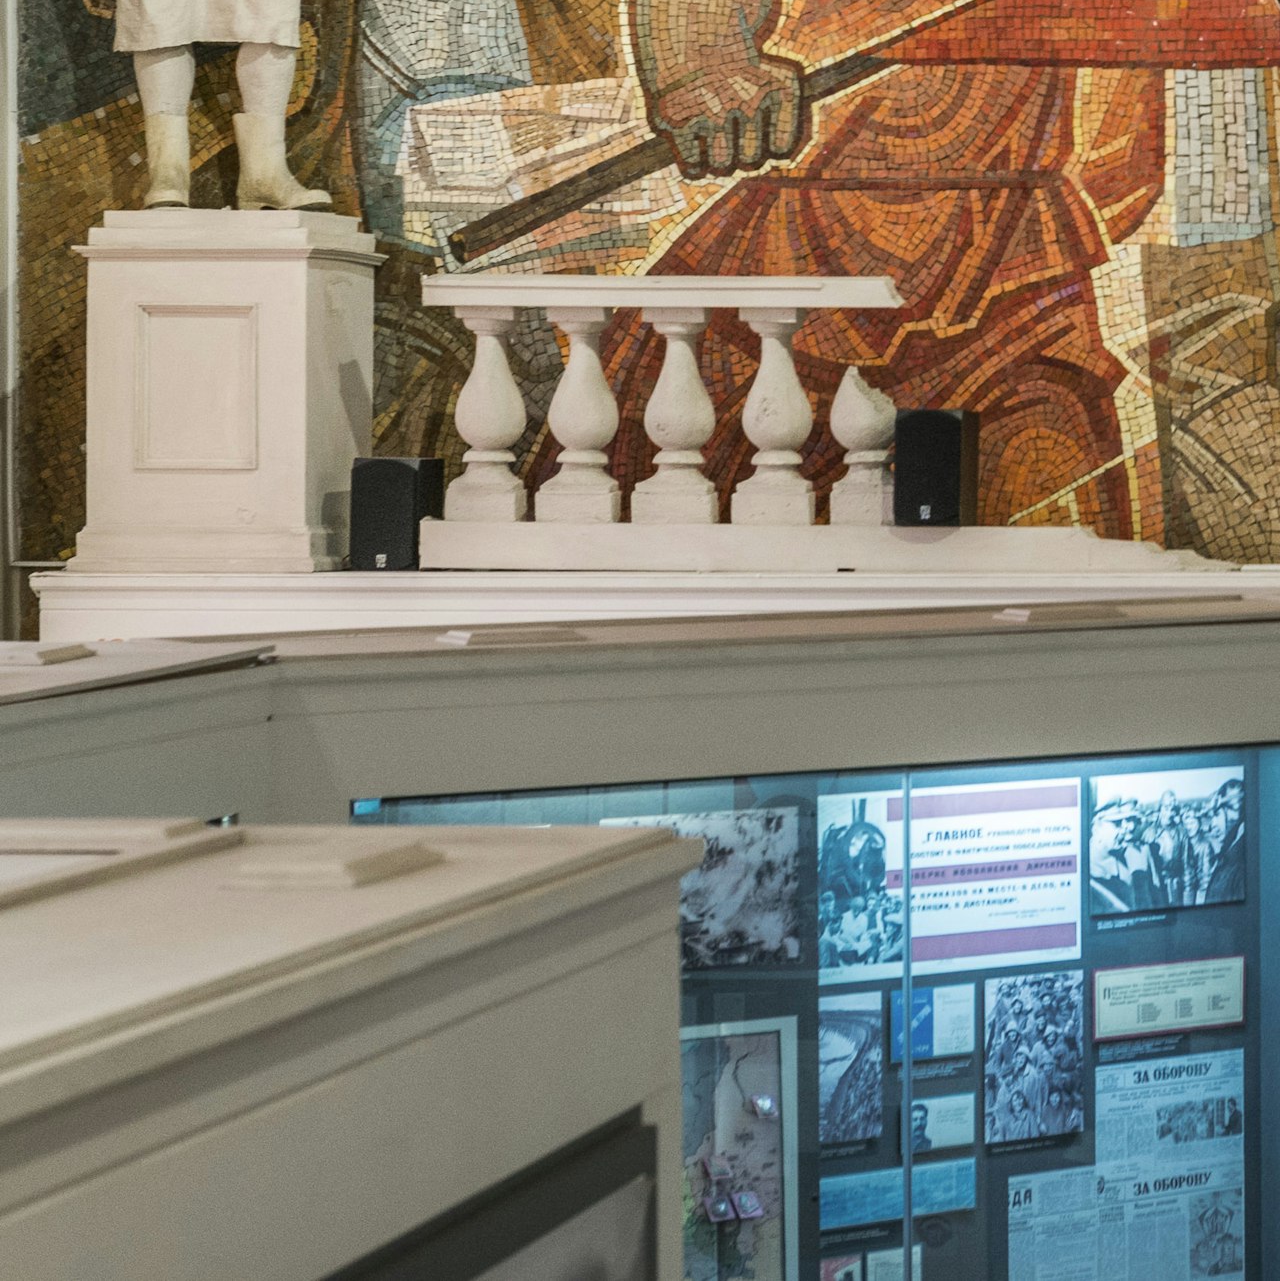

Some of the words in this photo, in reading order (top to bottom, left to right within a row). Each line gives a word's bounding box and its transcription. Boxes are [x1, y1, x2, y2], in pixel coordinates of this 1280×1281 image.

[893, 870, 946, 882] ПВЕРКЕ
[1133, 1069, 1150, 1084] ЗА
[1154, 1062, 1212, 1081] ОБОРОНУ
[1133, 1183, 1150, 1197] ЗА
[1153, 1171, 1212, 1193] ОБОРОНУ
[1008, 1188, 1033, 1209] ДА
